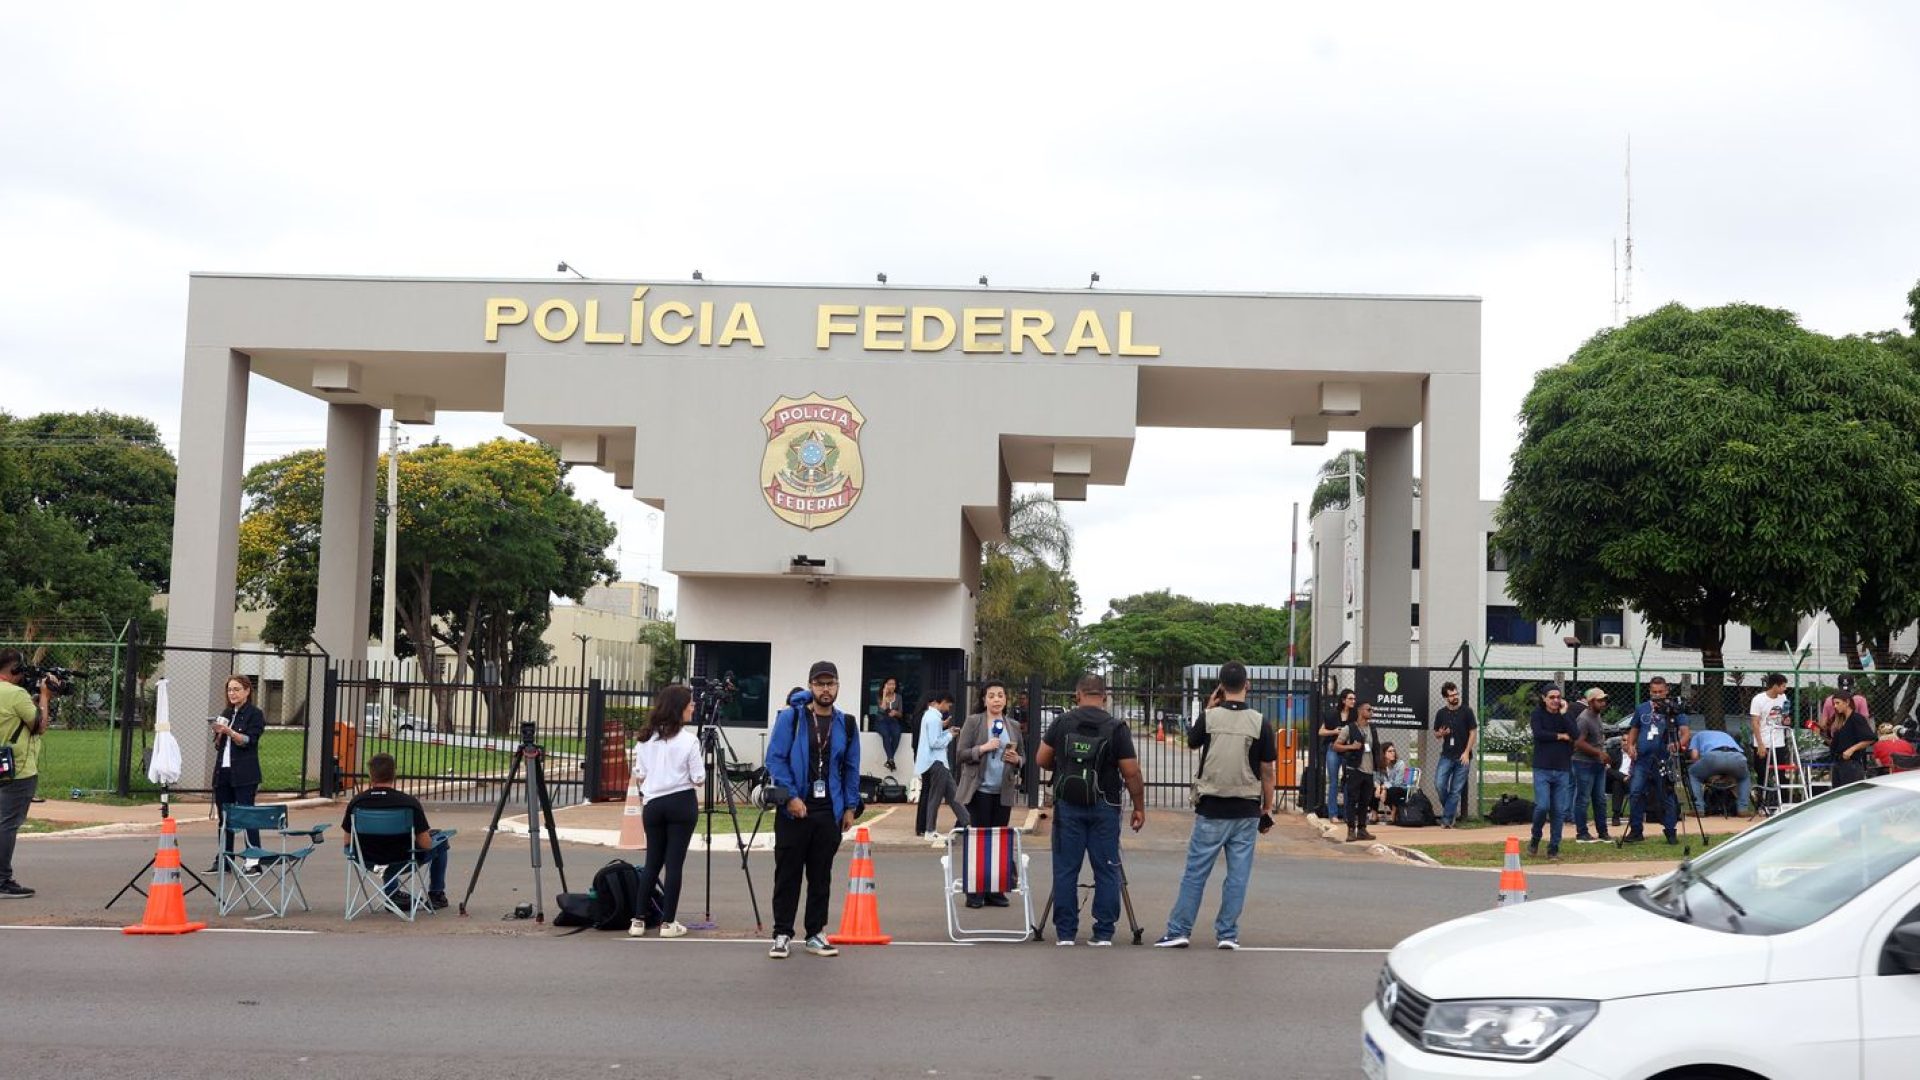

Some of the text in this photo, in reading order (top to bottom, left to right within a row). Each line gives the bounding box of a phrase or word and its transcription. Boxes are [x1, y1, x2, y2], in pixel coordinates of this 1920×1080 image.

[484, 286, 1161, 356] POLÍCIA FEDERAL
[776, 492, 846, 511] FEDERAL
[1377, 694, 1404, 704] PARE
[1073, 742, 1091, 750] TVU
